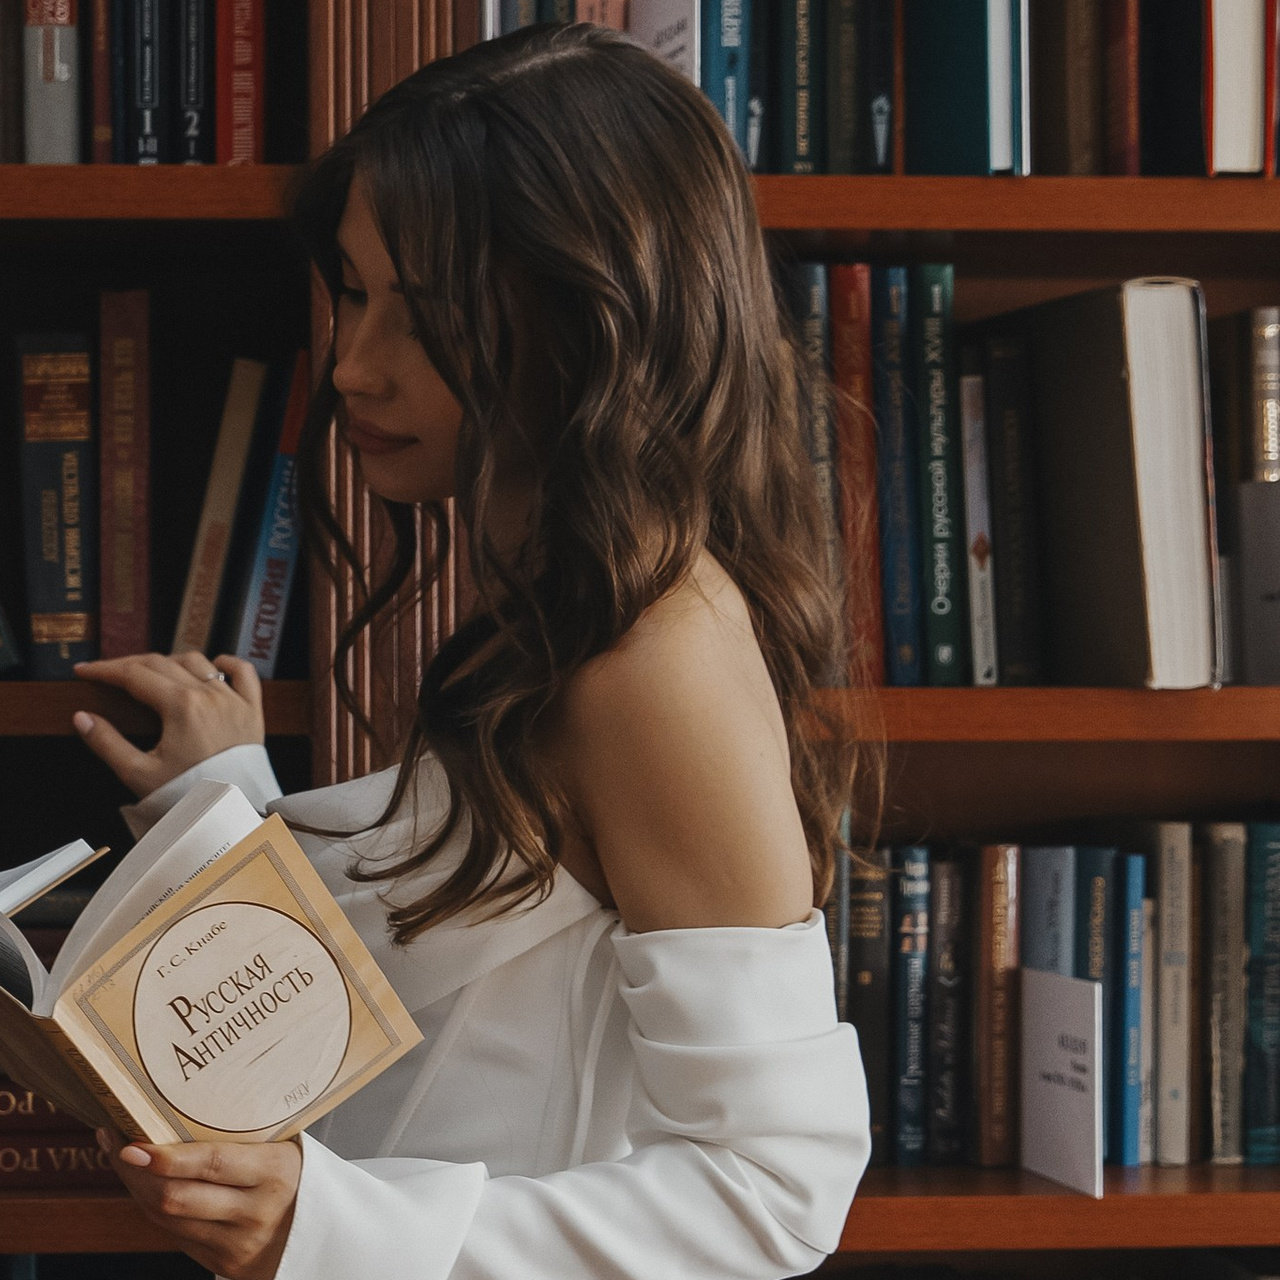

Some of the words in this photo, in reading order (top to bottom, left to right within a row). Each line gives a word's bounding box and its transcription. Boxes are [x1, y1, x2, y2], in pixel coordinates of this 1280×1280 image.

[142, 111, 153, 134] 1
[185, 111, 200, 137] 2
[927, 459, 951, 537] русской
[251, 558, 288, 661] ИСТОРИЯ
[157, 966, 171, 979] Г.
[170, 955, 186, 968] С.
[184, 919, 229, 953] Кнабе
[169, 966, 315, 1082] АНТИЧНОСТЬ
